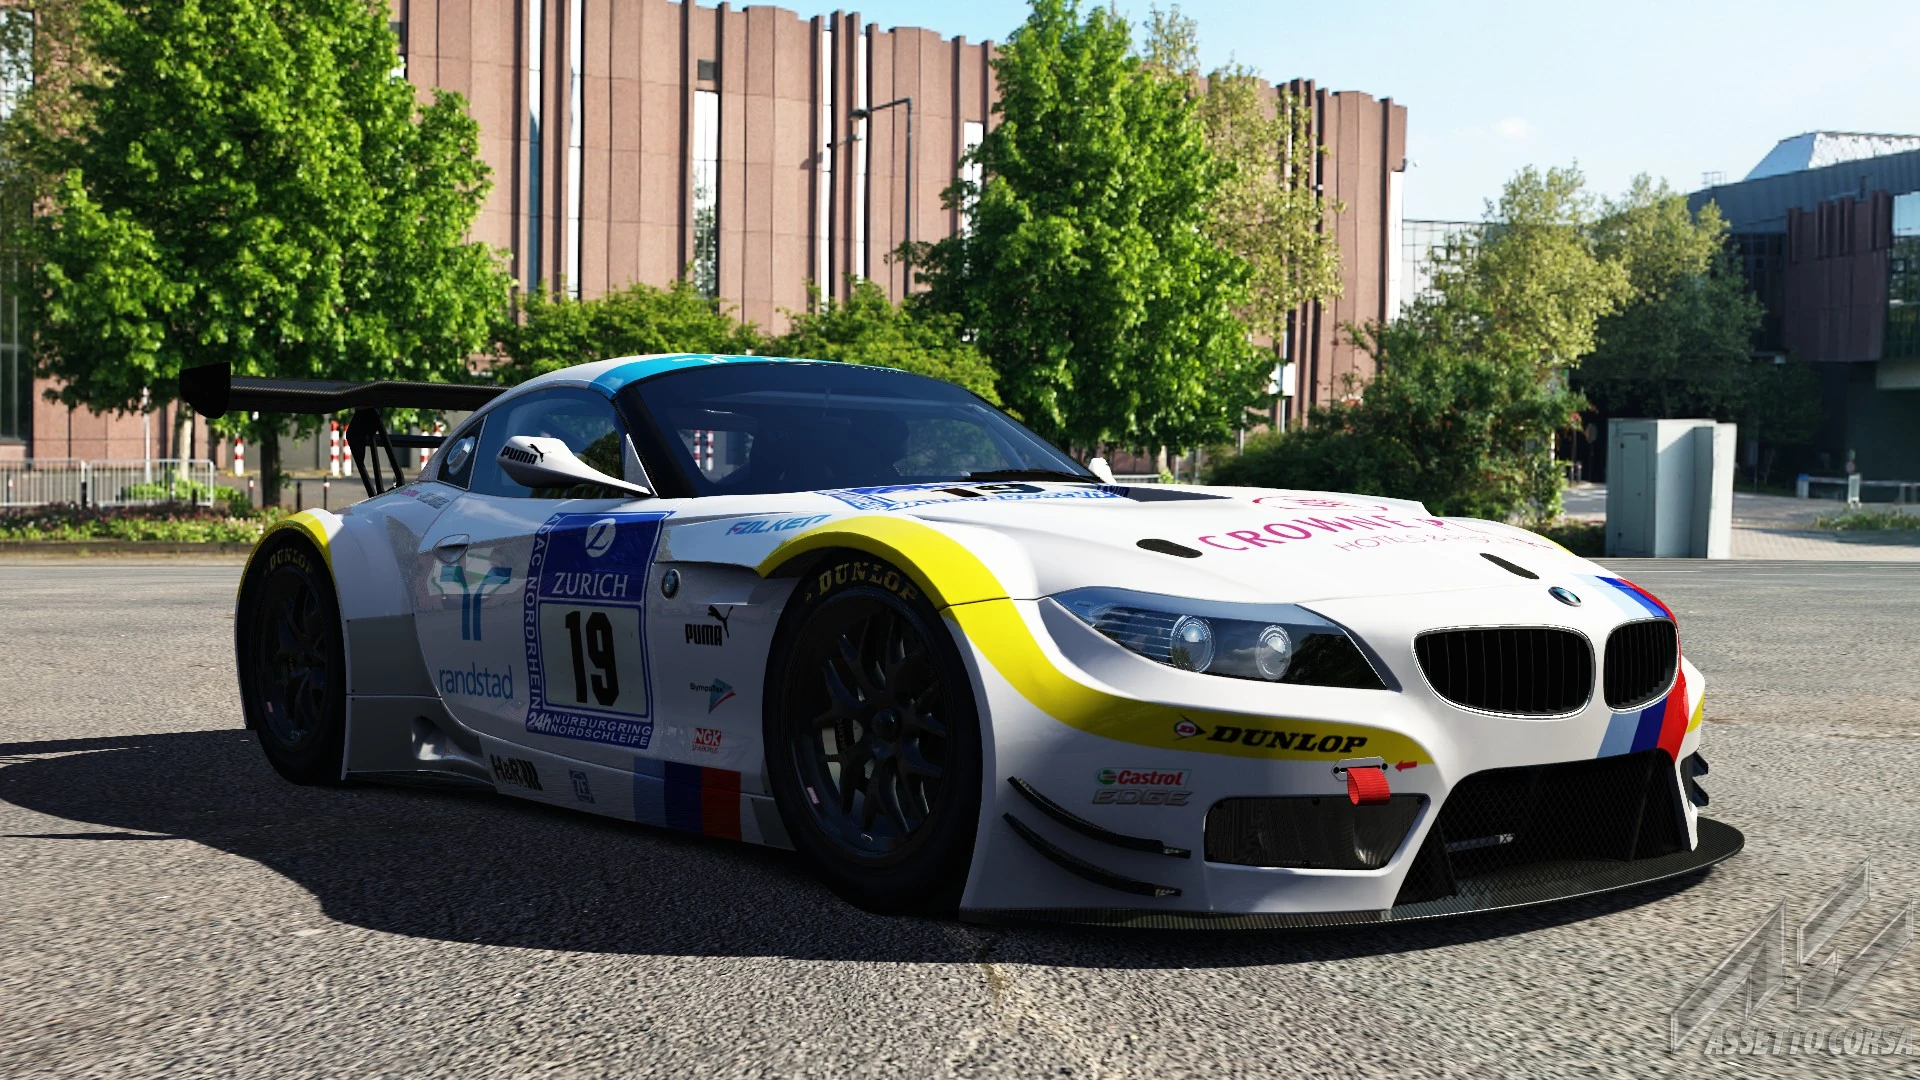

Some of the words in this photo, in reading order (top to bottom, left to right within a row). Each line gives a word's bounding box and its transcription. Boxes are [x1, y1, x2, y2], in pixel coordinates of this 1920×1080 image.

[501, 445, 539, 465] PUMA
[725, 514, 833, 536] FALKEN
[1198, 514, 1421, 551] CROWNE
[530, 514, 561, 568] ADAC
[269, 547, 314, 575] DUNLOP
[552, 572, 629, 599] ZURICH
[818, 560, 919, 601] DUNLOP
[524, 576, 542, 710] NORDRHEIN
[685, 623, 722, 646] PUMA
[565, 610, 619, 707] 19
[439, 663, 514, 699] randstad
[526, 711, 552, 732] 24h
[552, 713, 652, 737] NÜRBURGRING
[550, 723, 650, 747] NORDSCHLEIFE
[694, 728, 721, 746] NGK
[1207, 725, 1368, 753] DUNLOP
[1117, 769, 1184, 787] Castrol
[1091, 788, 1194, 806] EDGE
